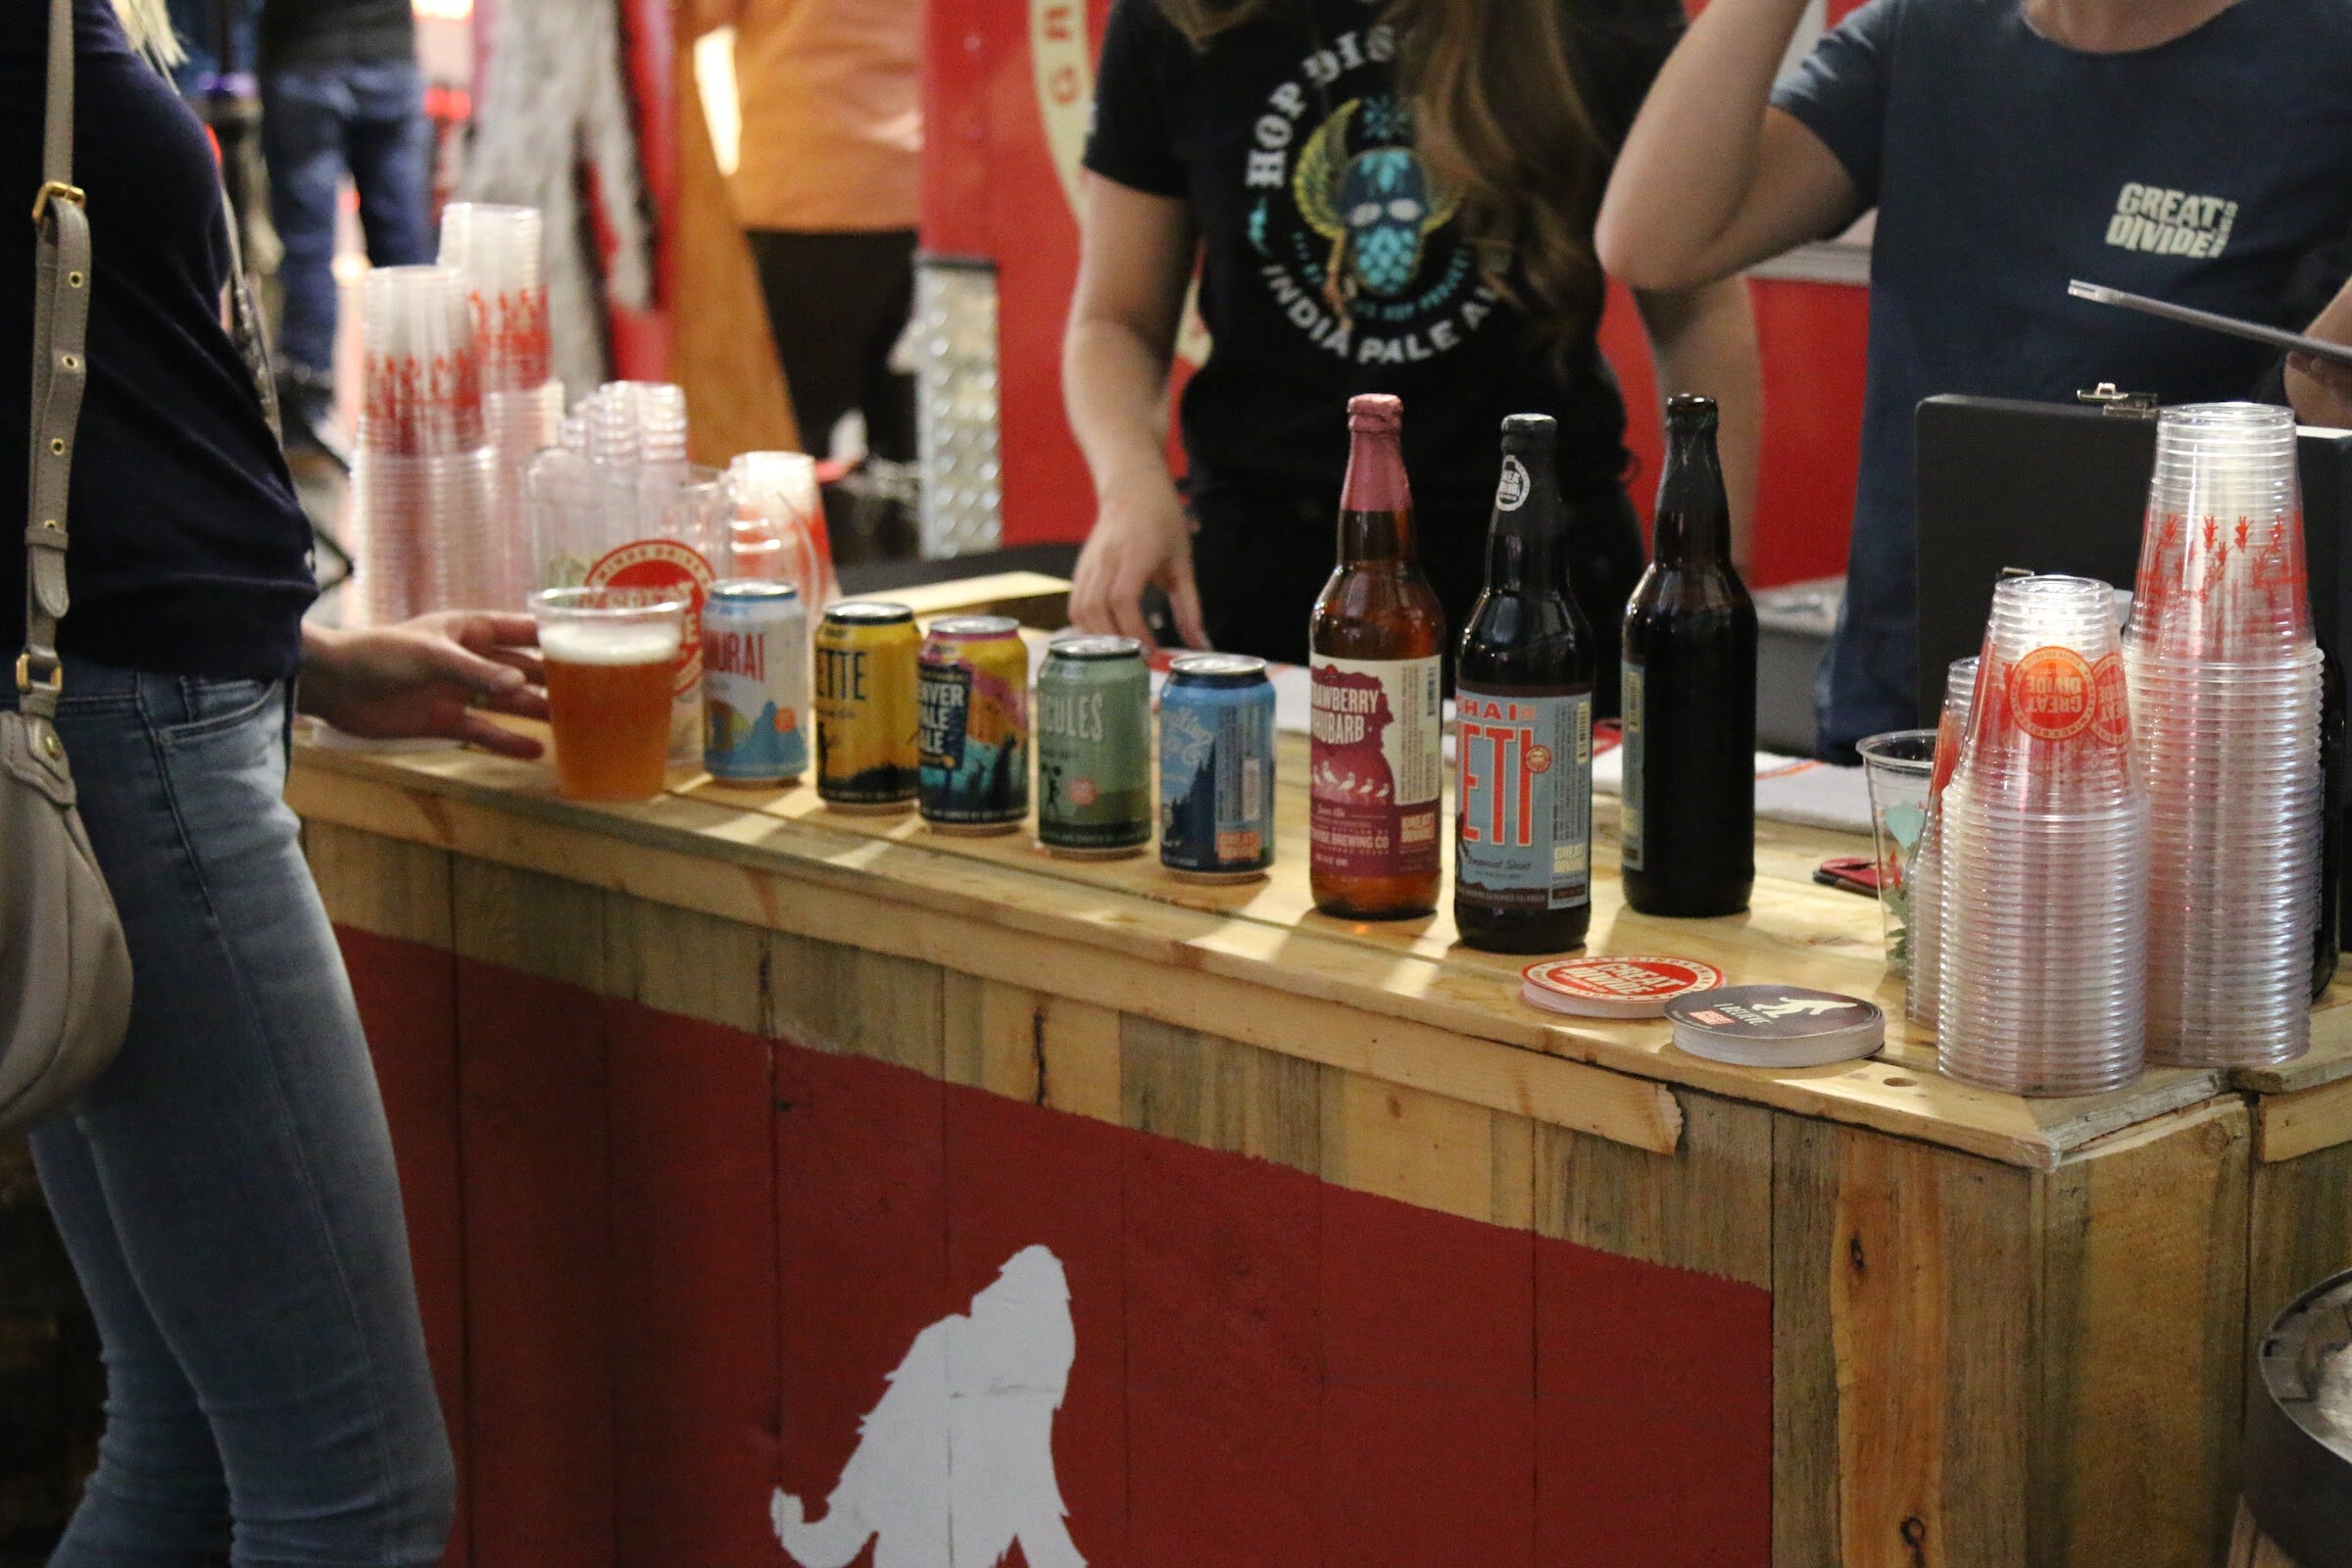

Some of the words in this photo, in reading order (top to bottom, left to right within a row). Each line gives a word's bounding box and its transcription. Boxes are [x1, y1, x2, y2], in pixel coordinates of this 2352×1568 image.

[1246, 81, 1307, 188] HOP
[2117, 181, 2225, 230] GREAT
[2105, 213, 2215, 259] DIVIDE
[1262, 265, 1352, 358] INDIA
[1357, 319, 1463, 365] PALE
[2025, 695, 2082, 713] GREAT
